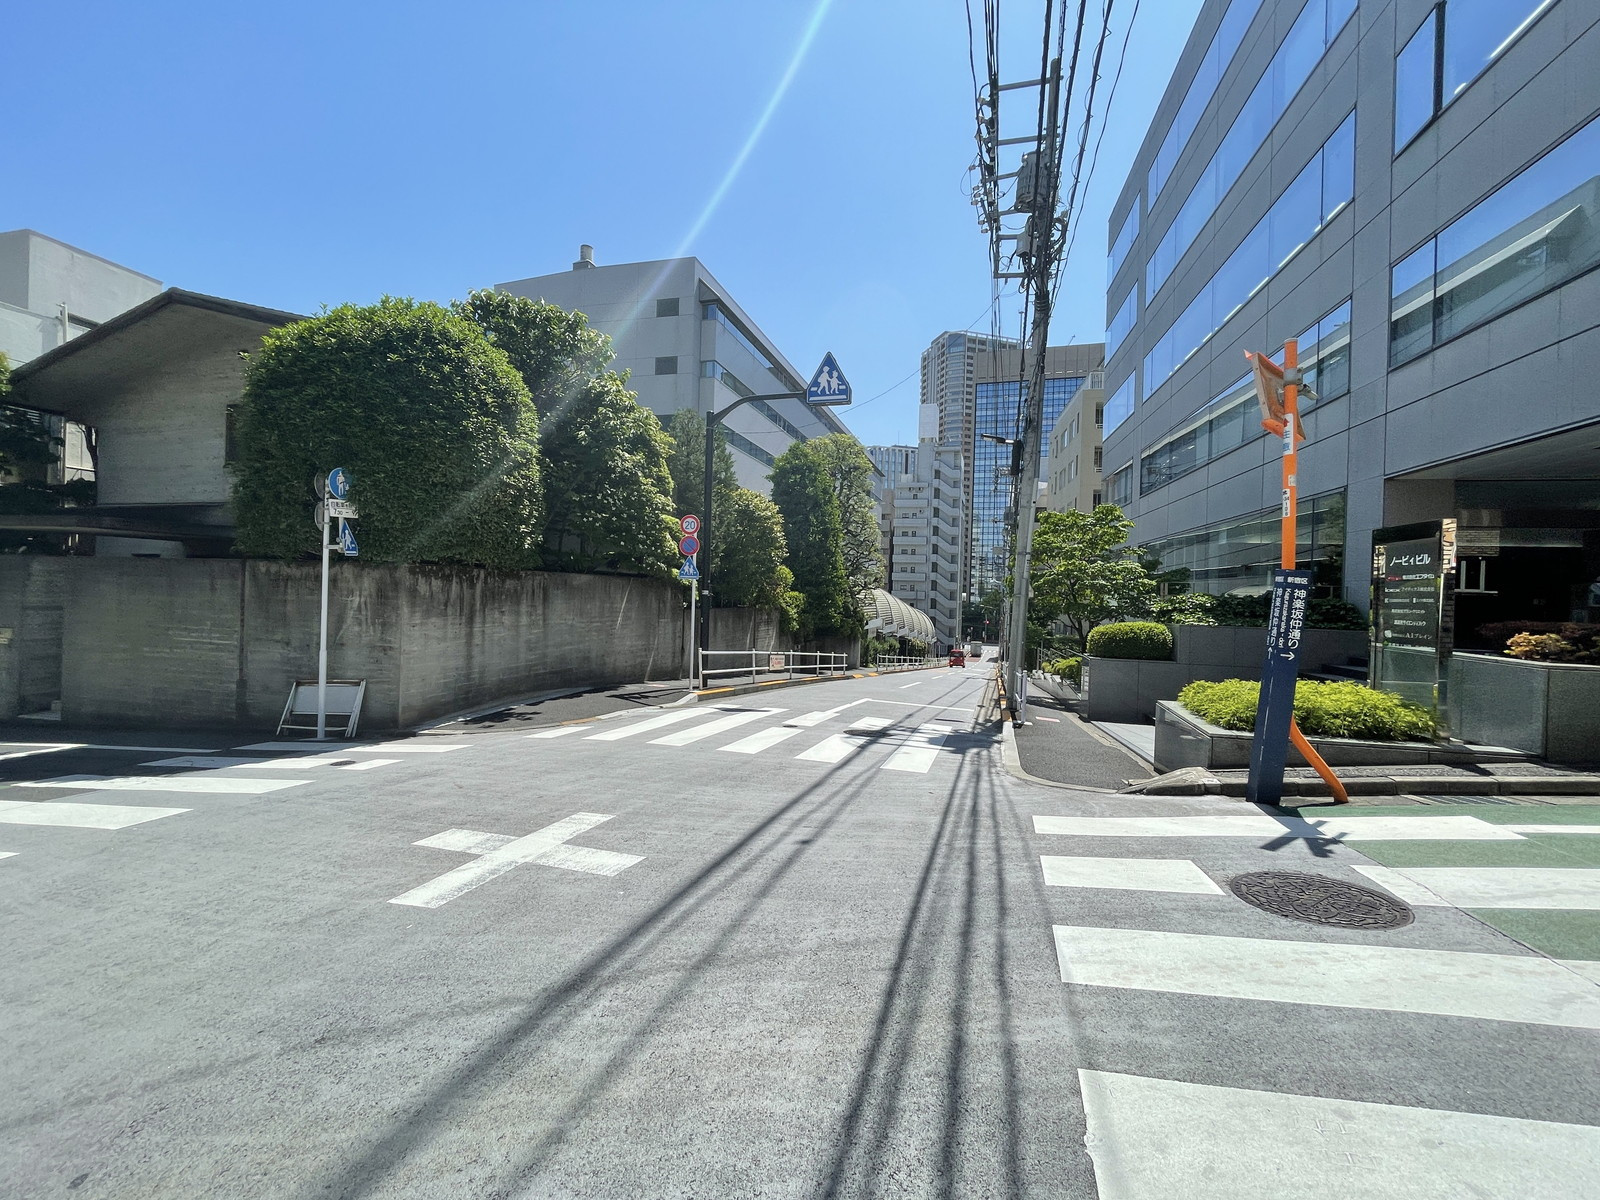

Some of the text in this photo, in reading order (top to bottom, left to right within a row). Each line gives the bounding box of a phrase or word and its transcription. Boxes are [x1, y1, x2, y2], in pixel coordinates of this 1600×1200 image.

[684, 520, 696, 530] 20
[1389, 553, 1431, 567] ノービィビル
[1287, 576, 1308, 585] 新宿区
[1287, 588, 1307, 650] 神楽坂仲通り
